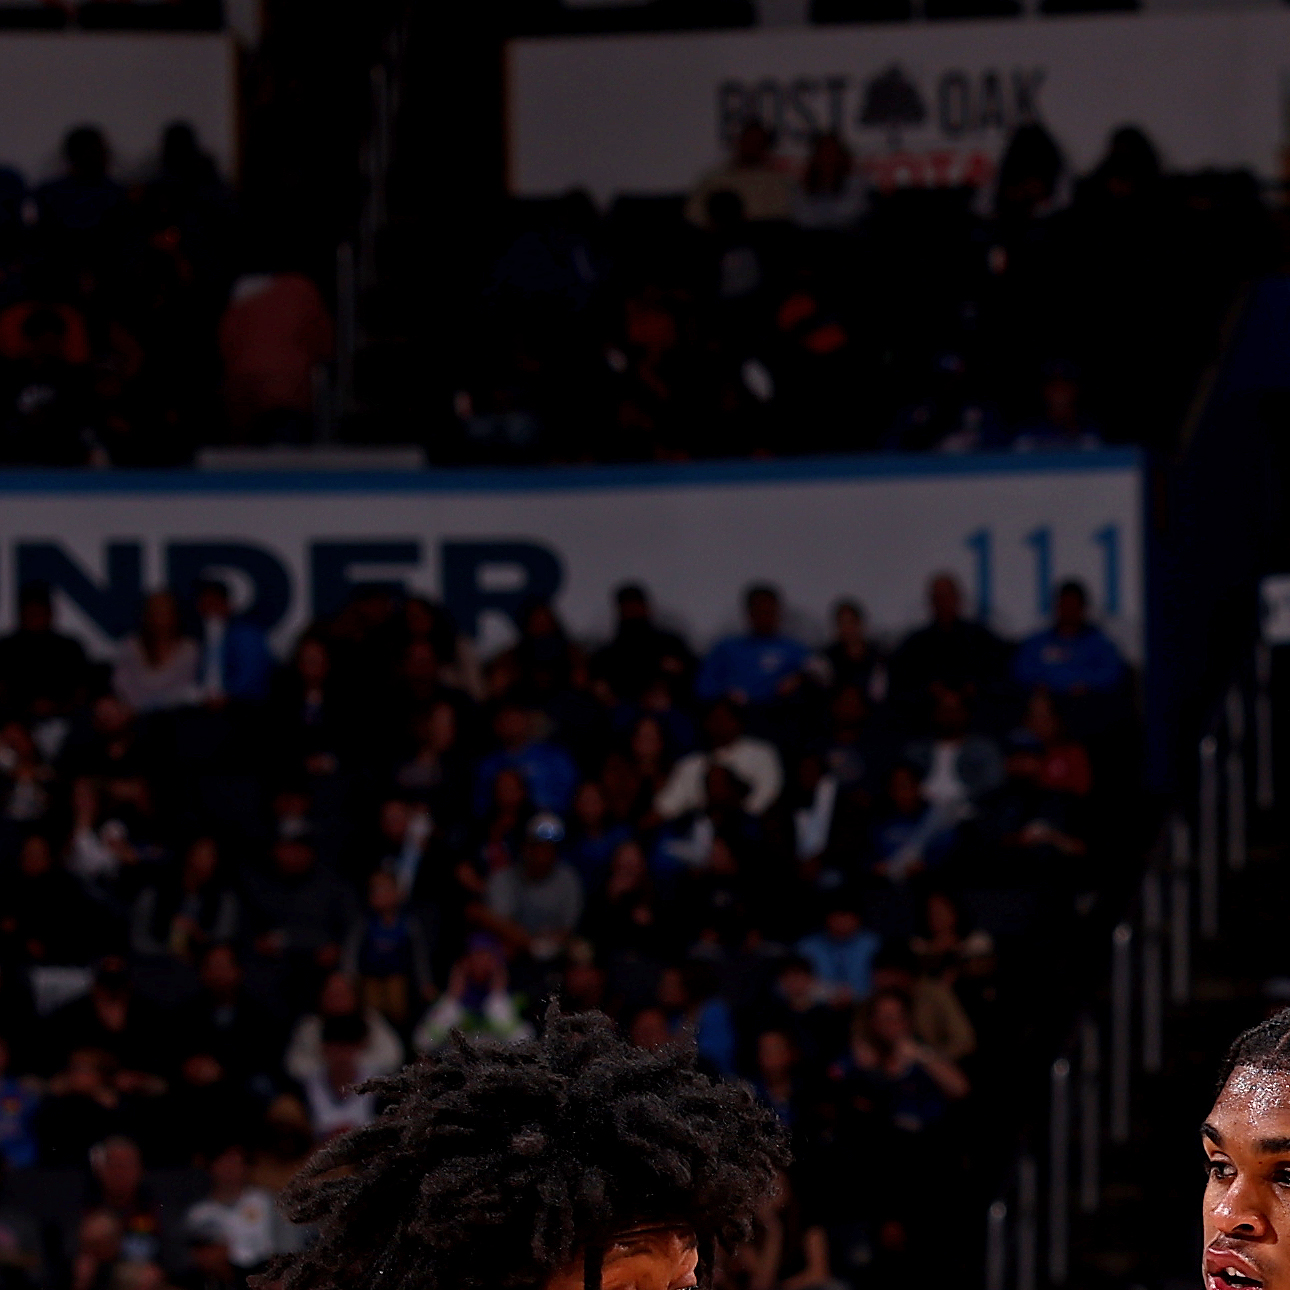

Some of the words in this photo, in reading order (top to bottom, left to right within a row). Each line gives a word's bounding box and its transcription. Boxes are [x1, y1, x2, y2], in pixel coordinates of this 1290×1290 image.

[718, 77, 846, 146] POST
[937, 65, 1047, 140] OAK
[966, 523, 1121, 622] 111
